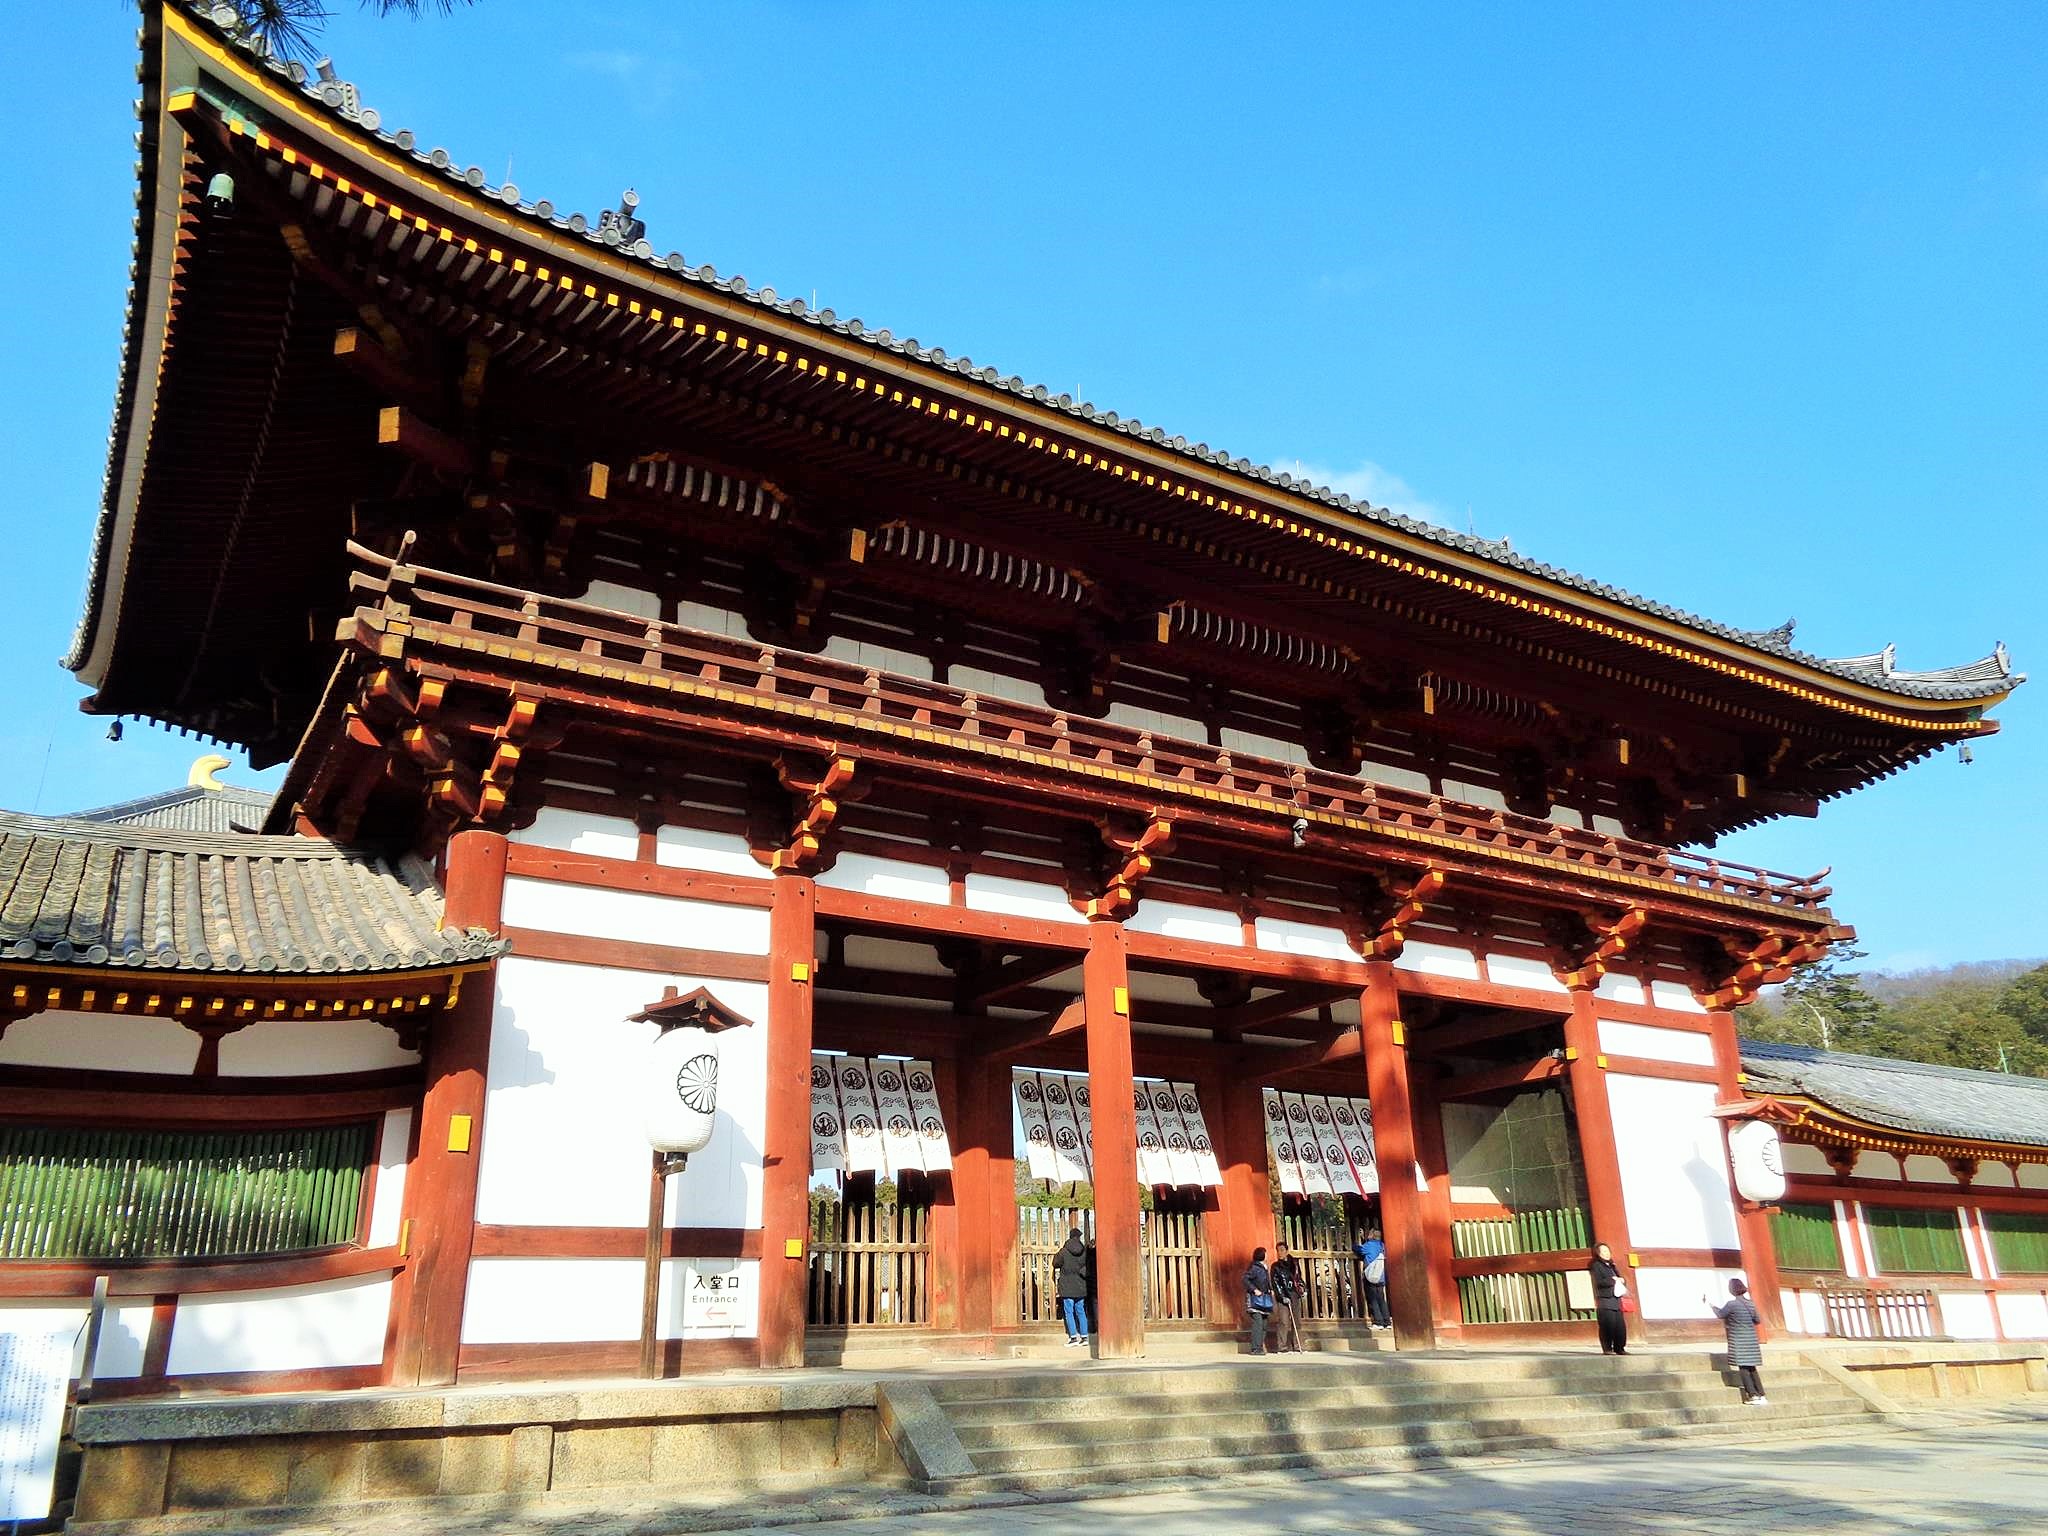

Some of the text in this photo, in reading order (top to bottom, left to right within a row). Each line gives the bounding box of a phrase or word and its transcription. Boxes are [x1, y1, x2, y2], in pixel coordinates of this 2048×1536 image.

[693, 1275, 739, 1290] 入堂口
[692, 1295, 738, 1304] Entrance
